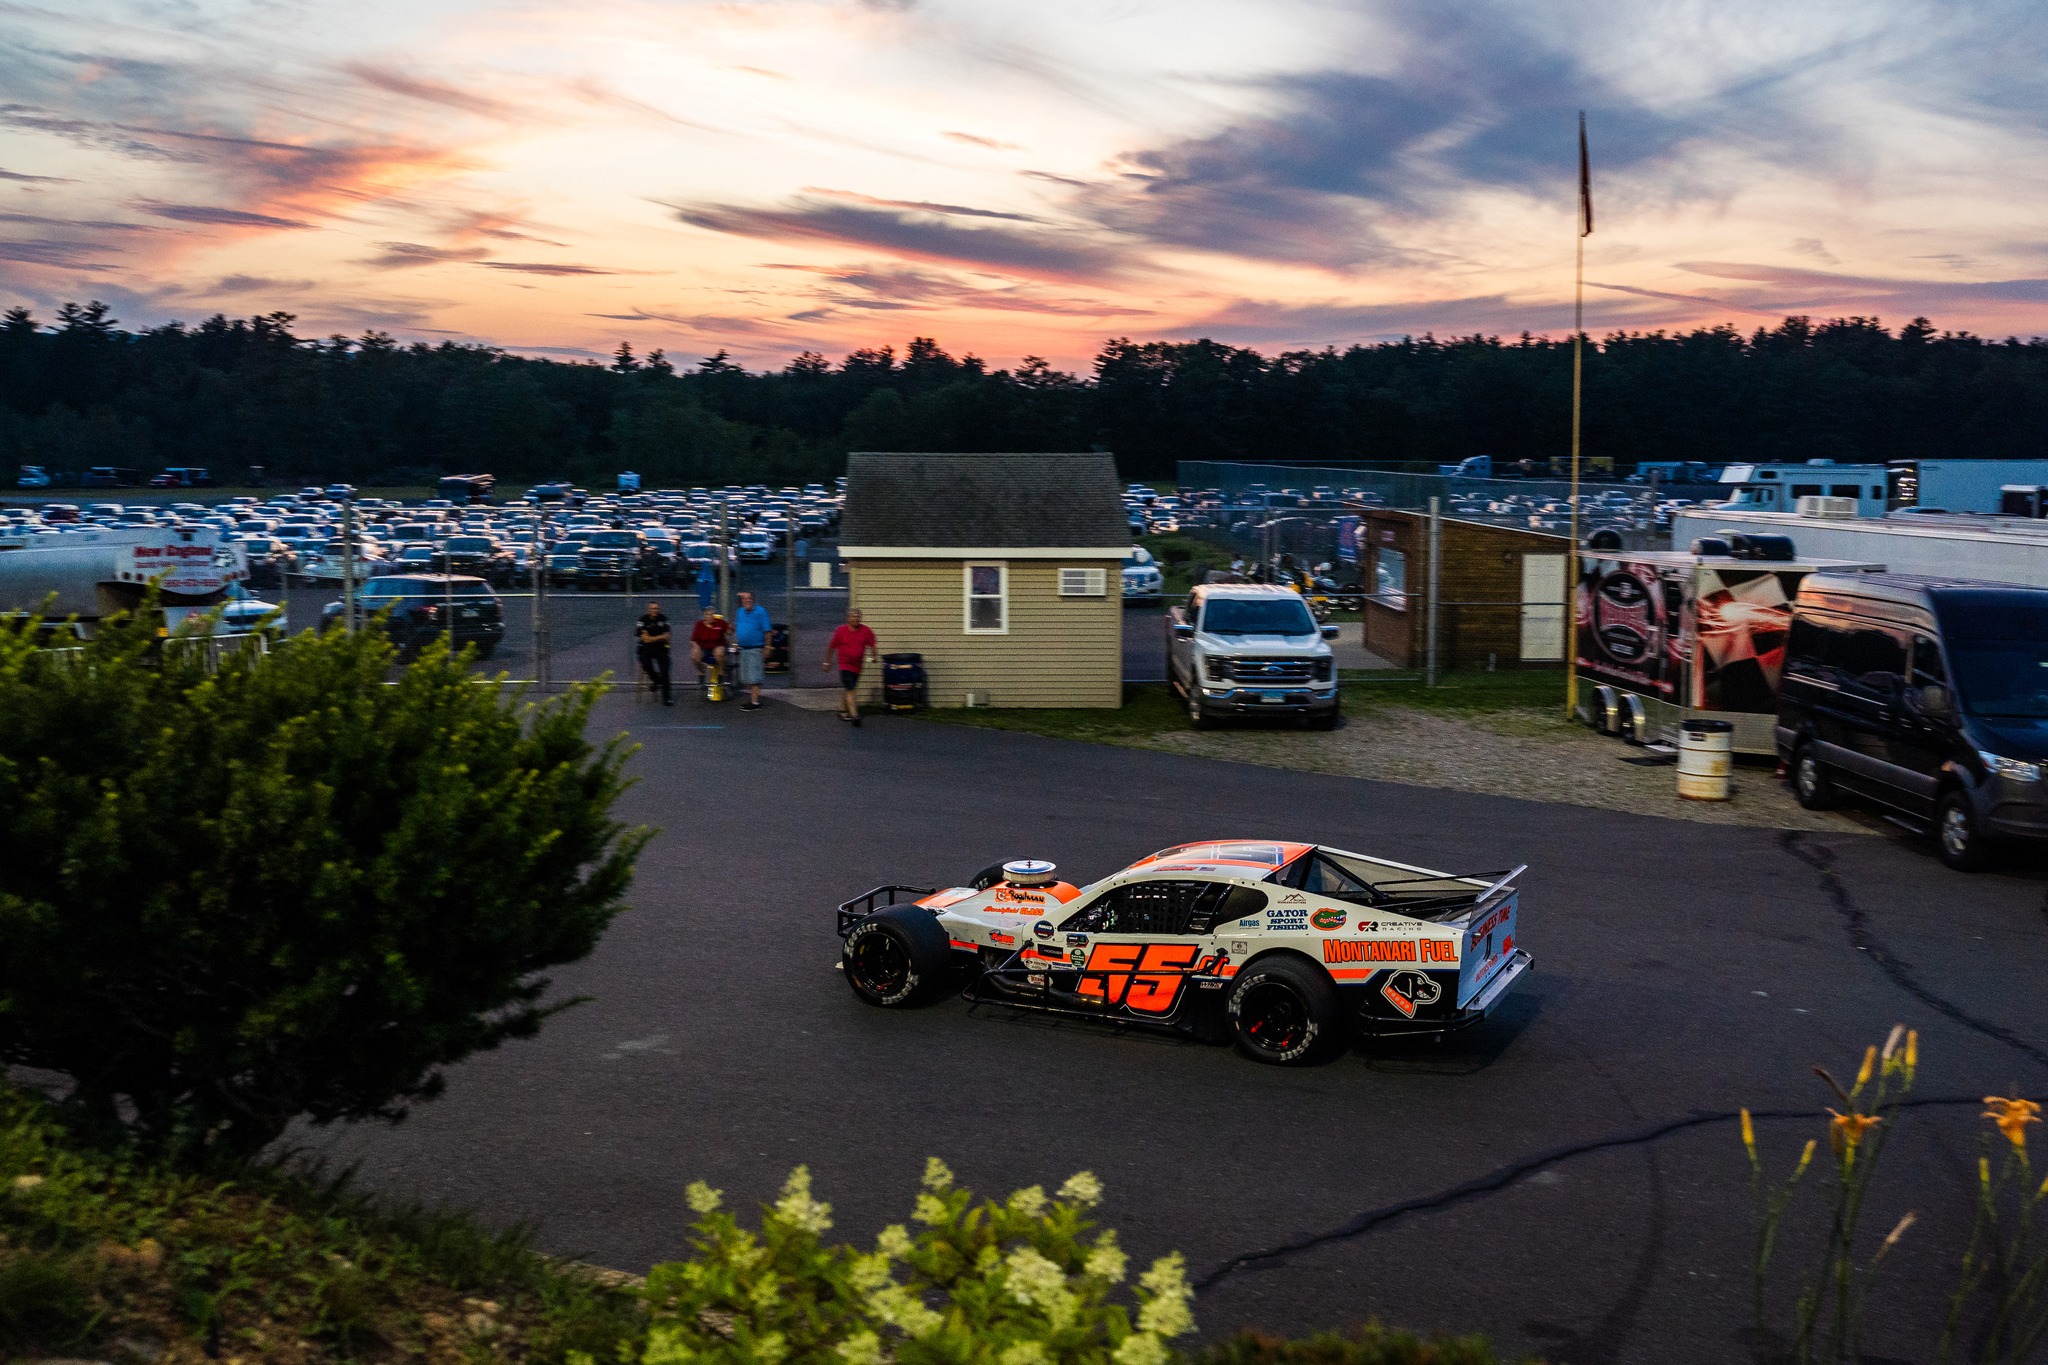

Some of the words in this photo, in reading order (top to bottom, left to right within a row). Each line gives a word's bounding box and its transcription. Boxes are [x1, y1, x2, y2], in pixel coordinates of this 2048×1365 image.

[1020, 907, 1045, 917] GLASS
[1239, 919, 1260, 928] Airgas
[1323, 939, 1417, 963] MONTANARI
[1420, 938, 1459, 963] FUEL
[1077, 943, 1198, 1013] 55
